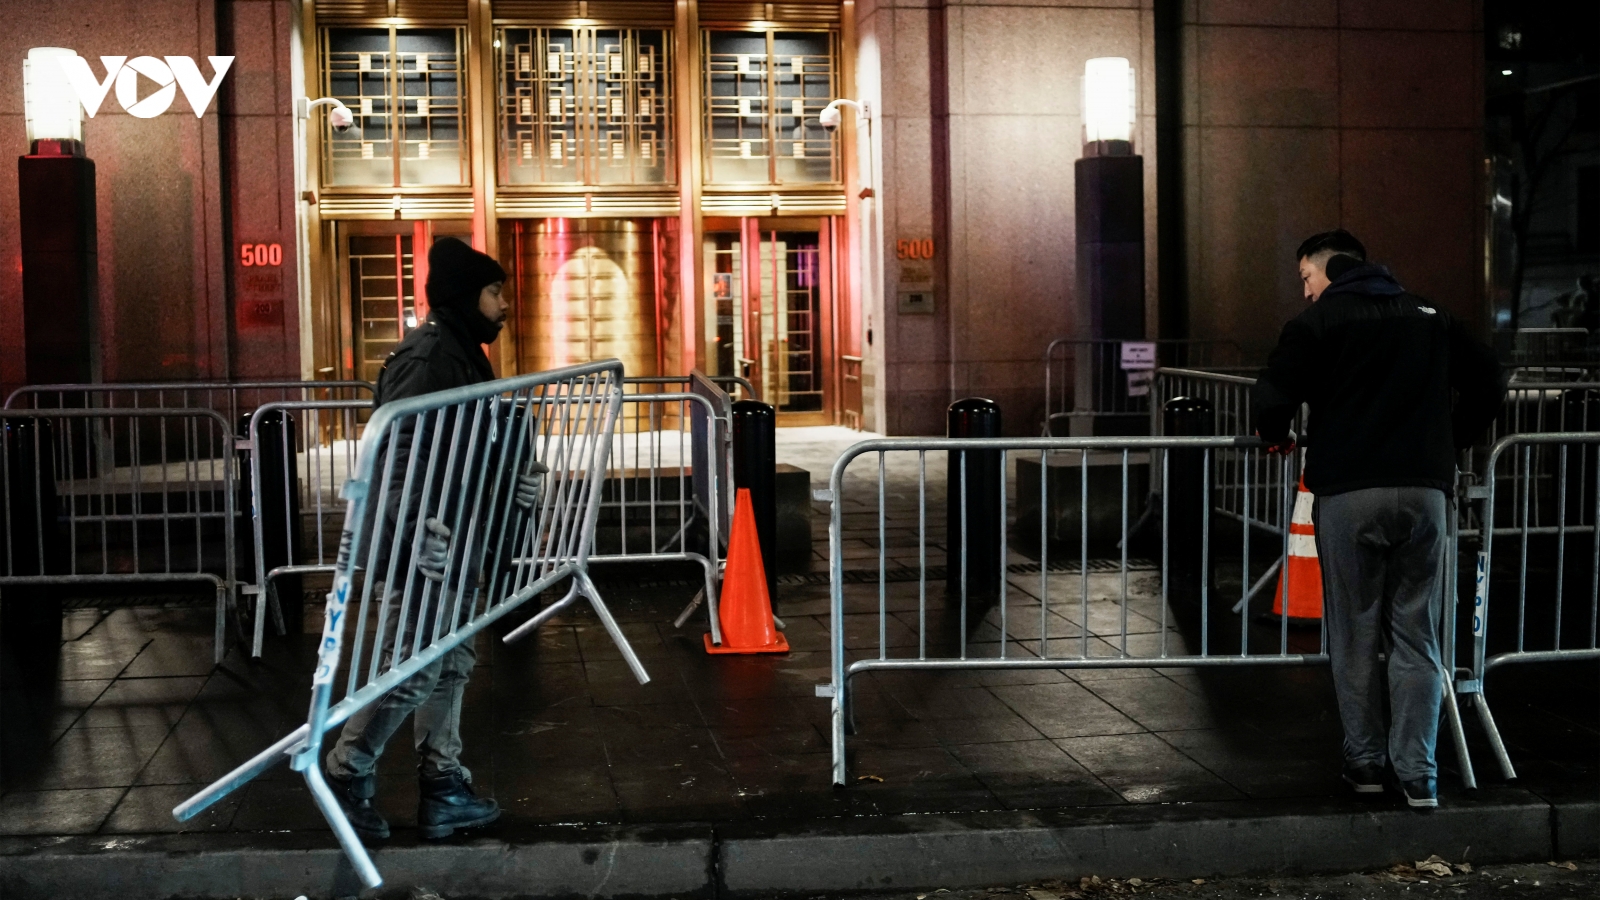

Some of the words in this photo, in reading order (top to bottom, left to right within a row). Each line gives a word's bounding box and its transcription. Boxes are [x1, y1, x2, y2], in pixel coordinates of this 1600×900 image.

[241, 243, 282, 267] 500
[896, 239, 935, 260] 500
[255, 303, 271, 314] 200
